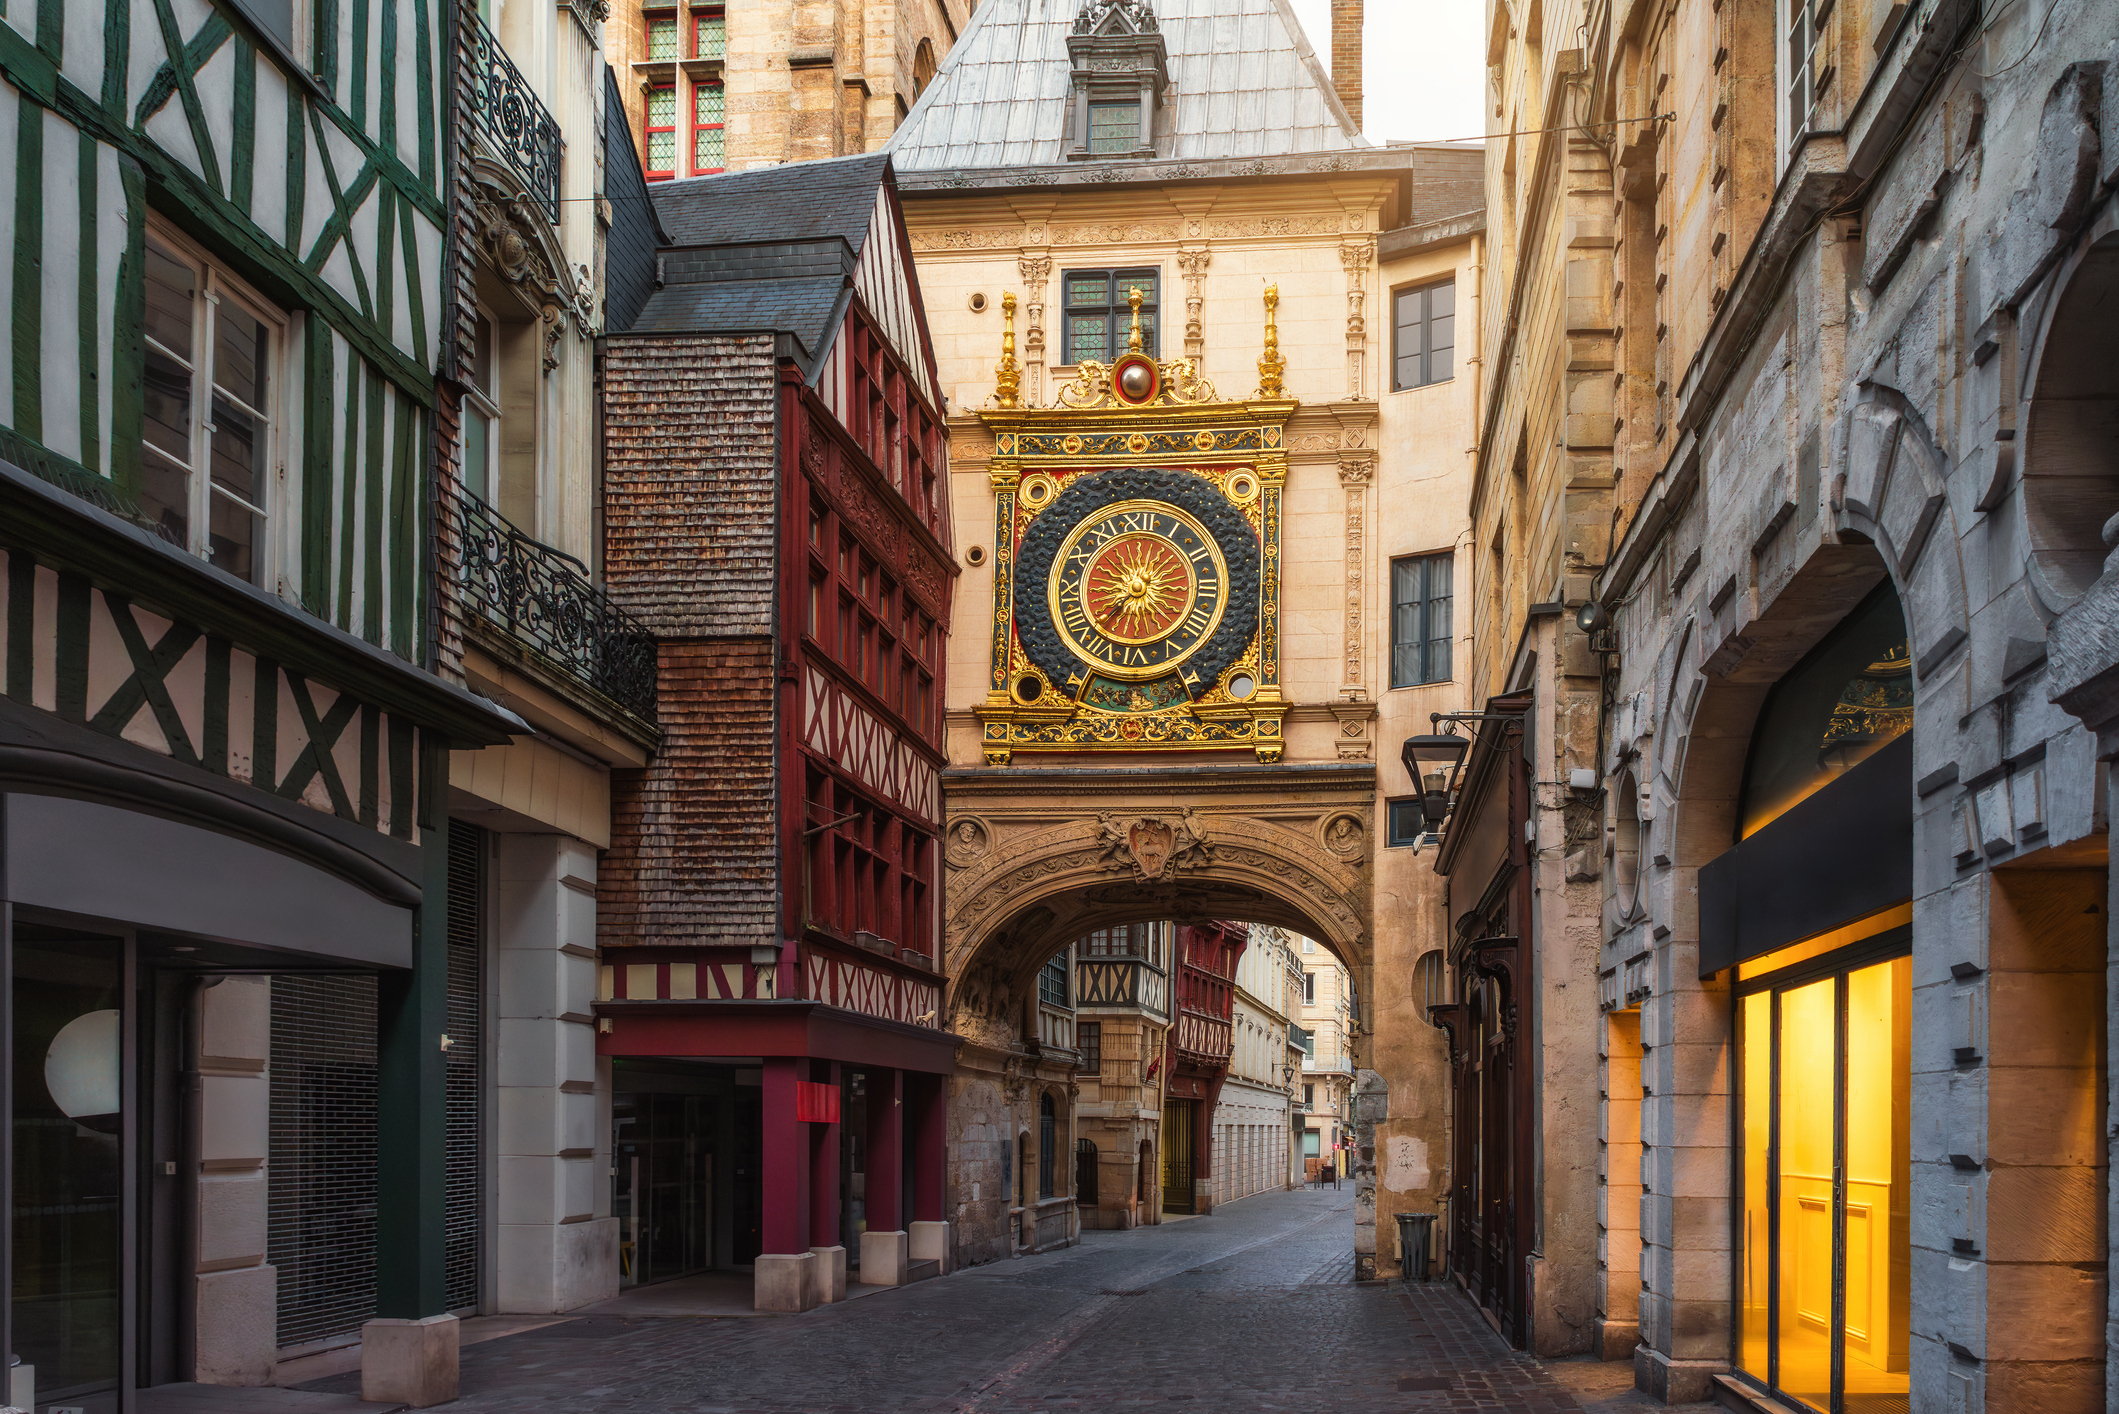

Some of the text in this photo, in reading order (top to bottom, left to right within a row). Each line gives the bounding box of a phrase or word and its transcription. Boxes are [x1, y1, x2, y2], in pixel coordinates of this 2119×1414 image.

[1090, 519, 1118, 546] XI
[1122, 513, 1155, 531] XII
[1168, 522, 1180, 538] I
[1069, 545, 1091, 568] X
[1189, 546, 1209, 563] II
[1061, 579, 1079, 603] IX
[1199, 579, 1217, 598] III
[1063, 607, 1090, 644] VIII
[1183, 608, 1210, 637] IIII
[1086, 635, 1113, 662] VII
[1123, 647, 1148, 665] VI
[1165, 639, 1183, 658] V
